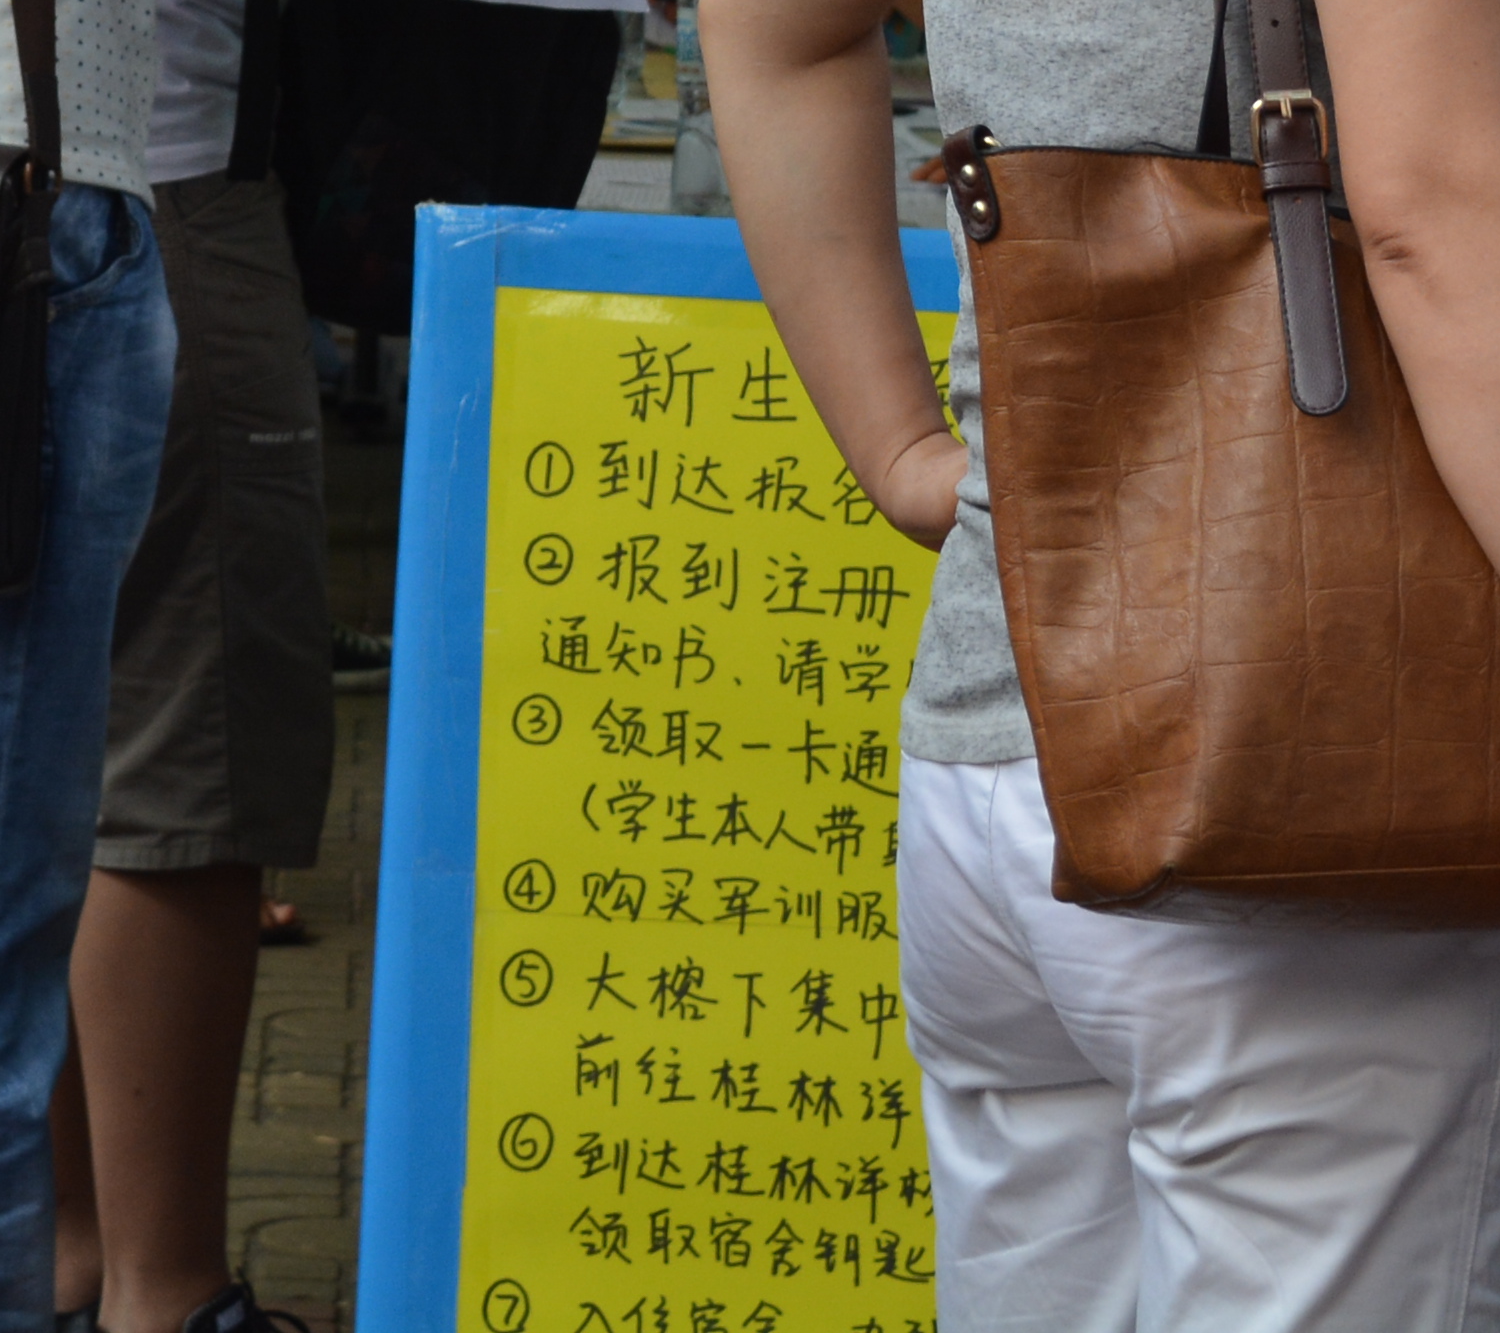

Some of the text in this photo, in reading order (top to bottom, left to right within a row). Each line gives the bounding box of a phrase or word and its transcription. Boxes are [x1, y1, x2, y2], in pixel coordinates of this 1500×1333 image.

[540, 615, 914, 707] 通知书、请学
